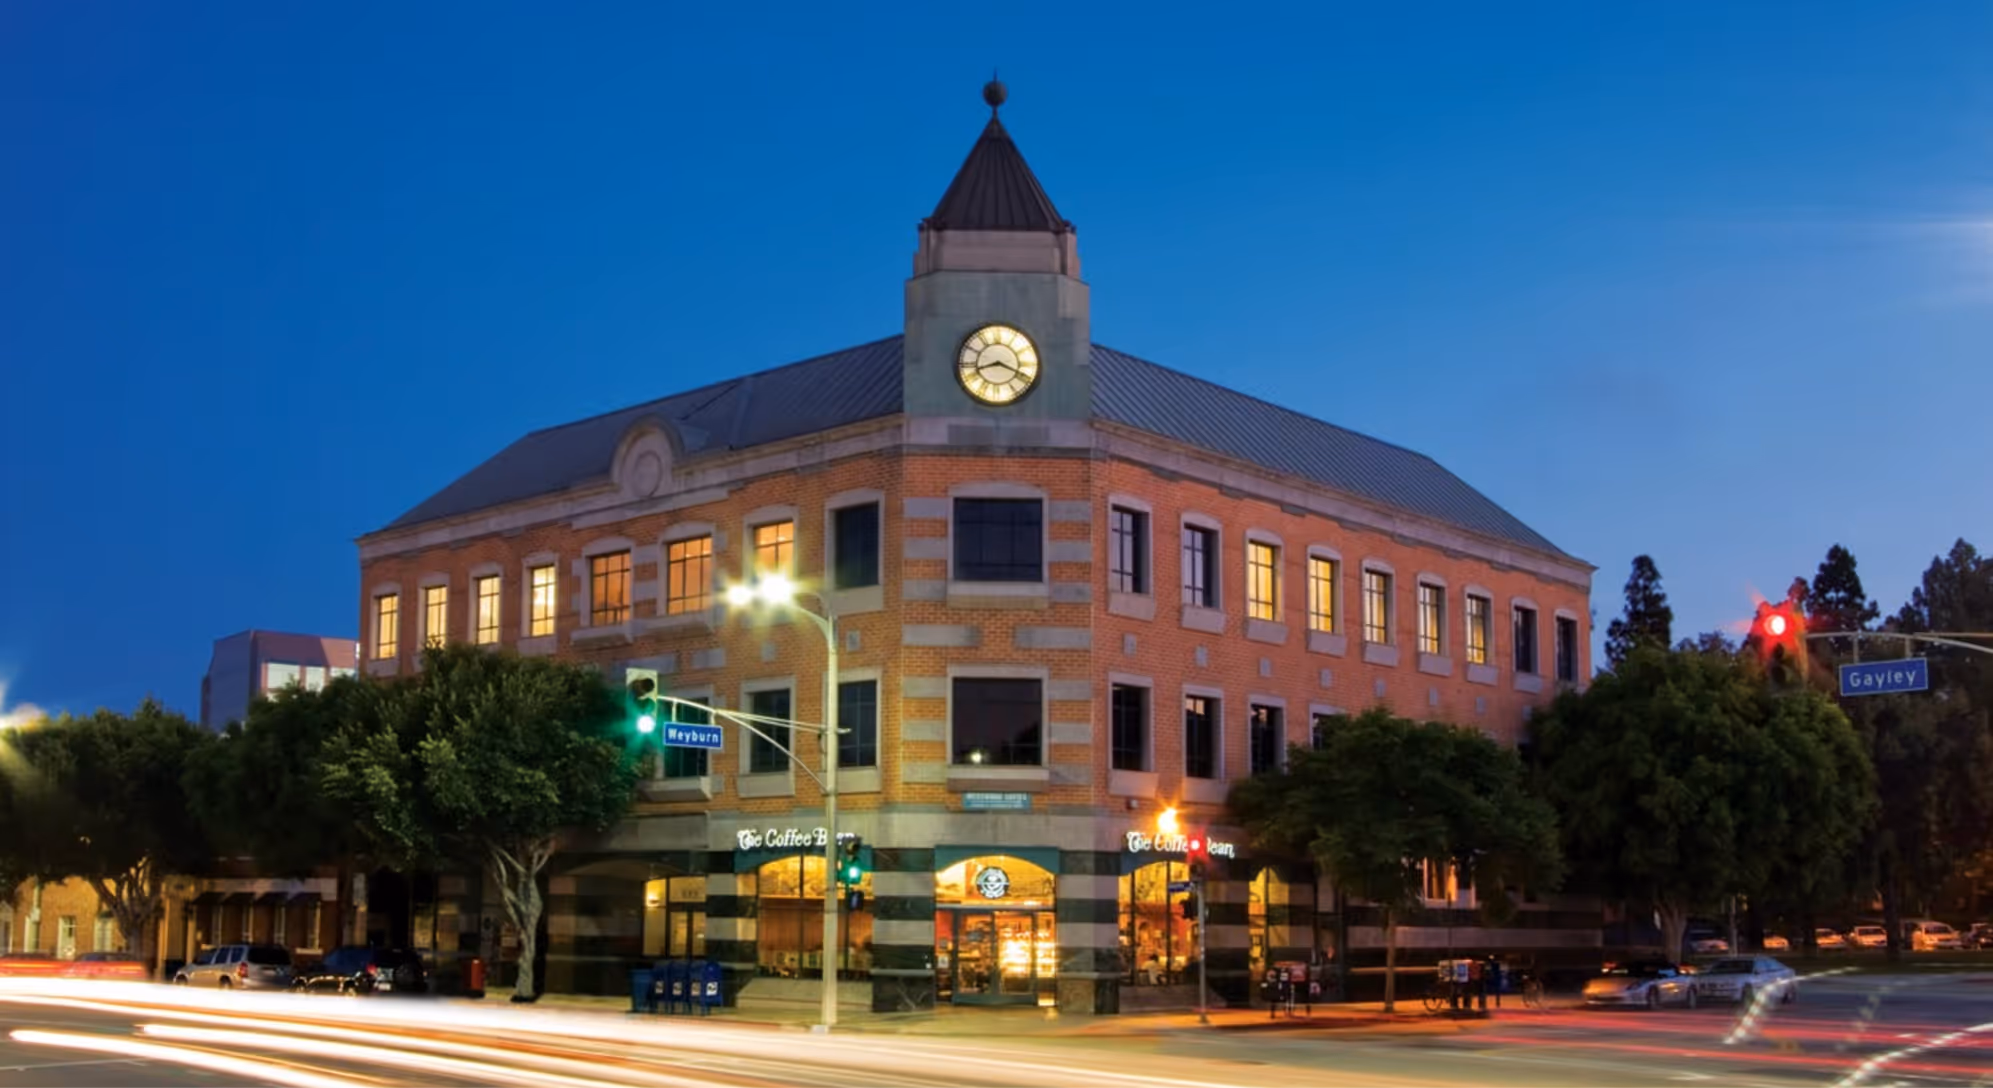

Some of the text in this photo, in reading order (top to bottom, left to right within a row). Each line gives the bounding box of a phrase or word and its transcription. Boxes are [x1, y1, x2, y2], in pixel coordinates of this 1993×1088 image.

[1849, 670, 1916, 689] Gayley
[667, 728, 719, 743] Weyburn
[737, 828, 762, 850] The
[765, 828, 812, 848] Coffee
[1126, 831, 1152, 853] The
[1154, 833, 1190, 852] Coffe
